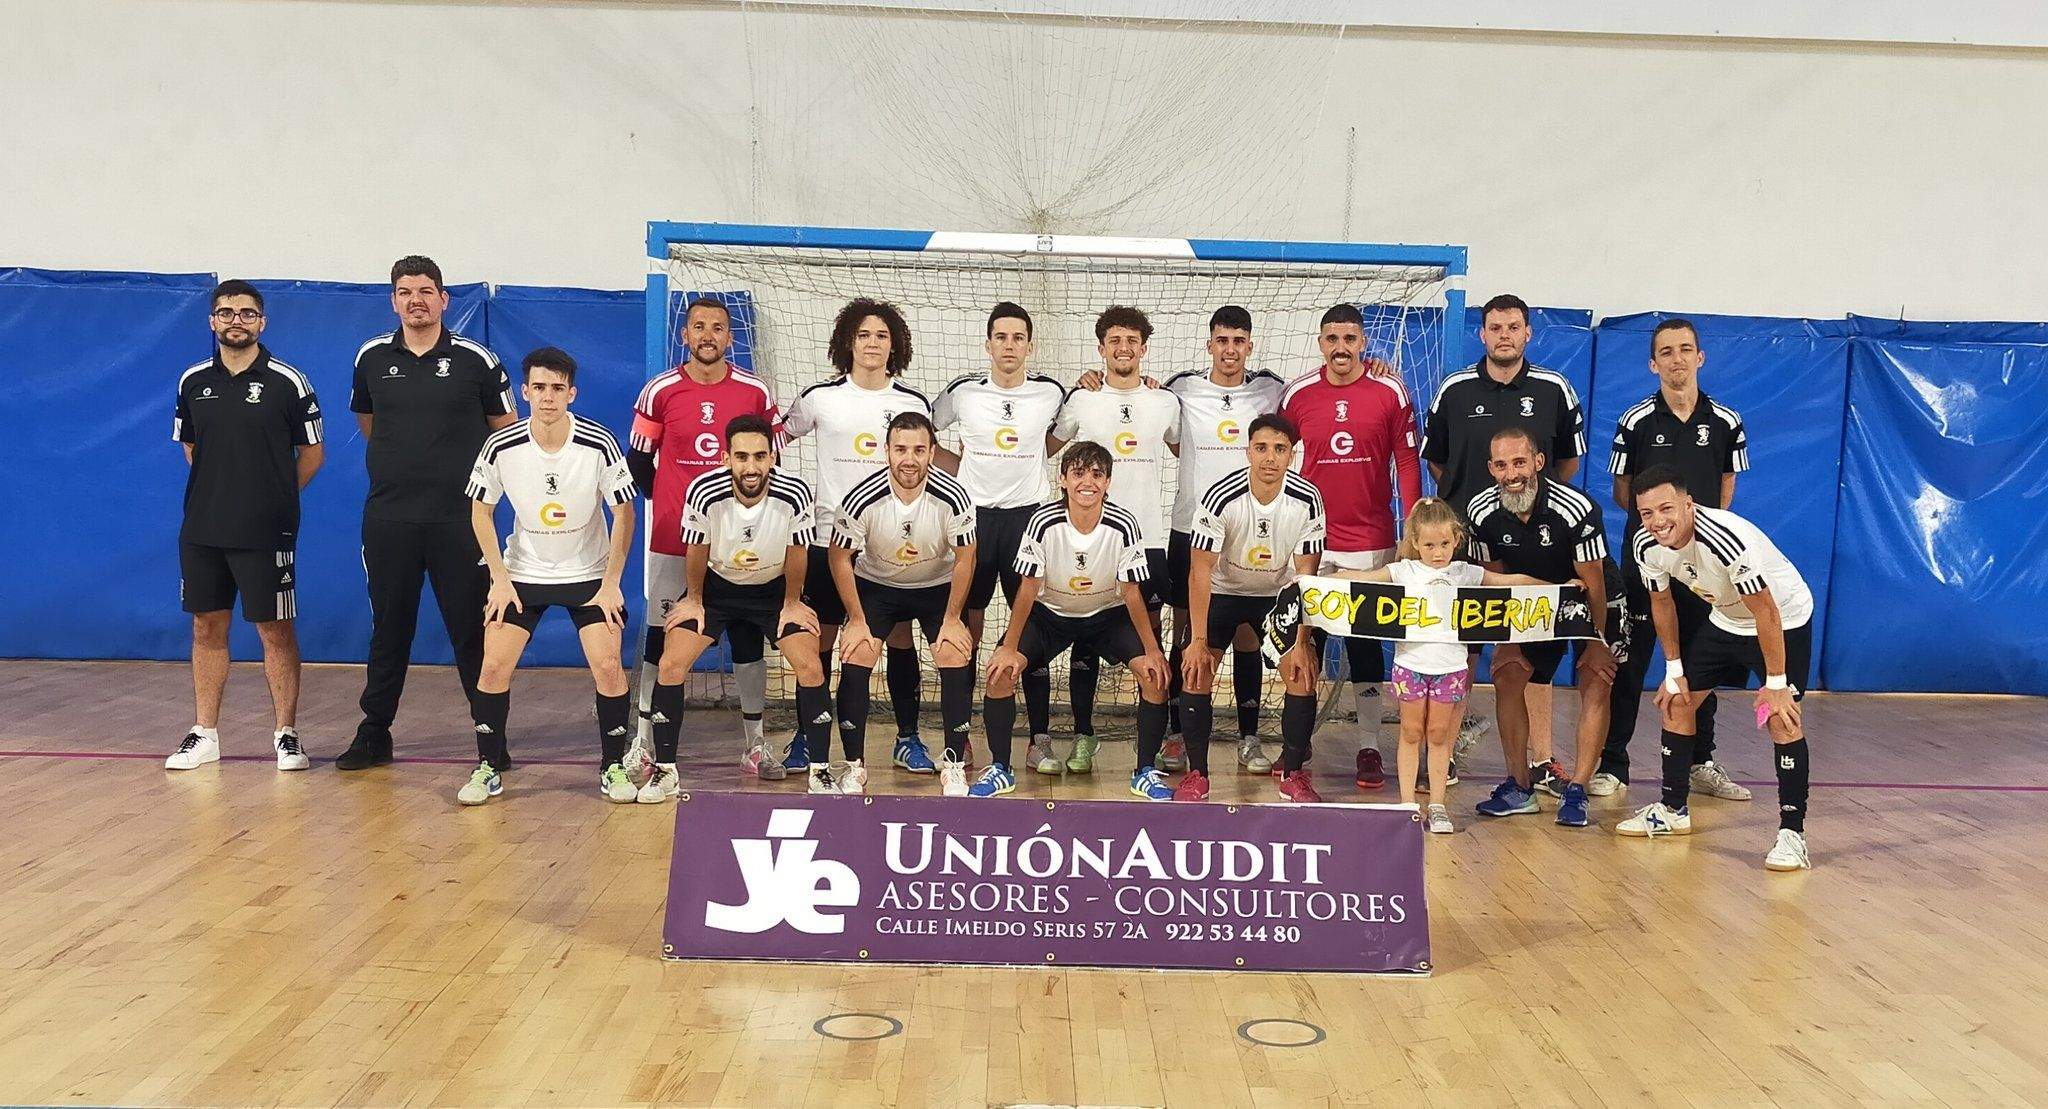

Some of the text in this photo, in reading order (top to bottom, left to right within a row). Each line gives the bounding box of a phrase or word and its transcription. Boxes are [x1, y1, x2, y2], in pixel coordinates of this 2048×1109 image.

[1302, 587, 1367, 626] SOY
[1376, 595, 1443, 628] DEL
[1450, 595, 1554, 633] IBERIA
[876, 880, 1071, 915] ASESORES
[1114, 885, 1406, 923] CONSULTORES
[876, 916, 1301, 943] CALLE IMELDO SERIS 57 2A 922 53 44 80
